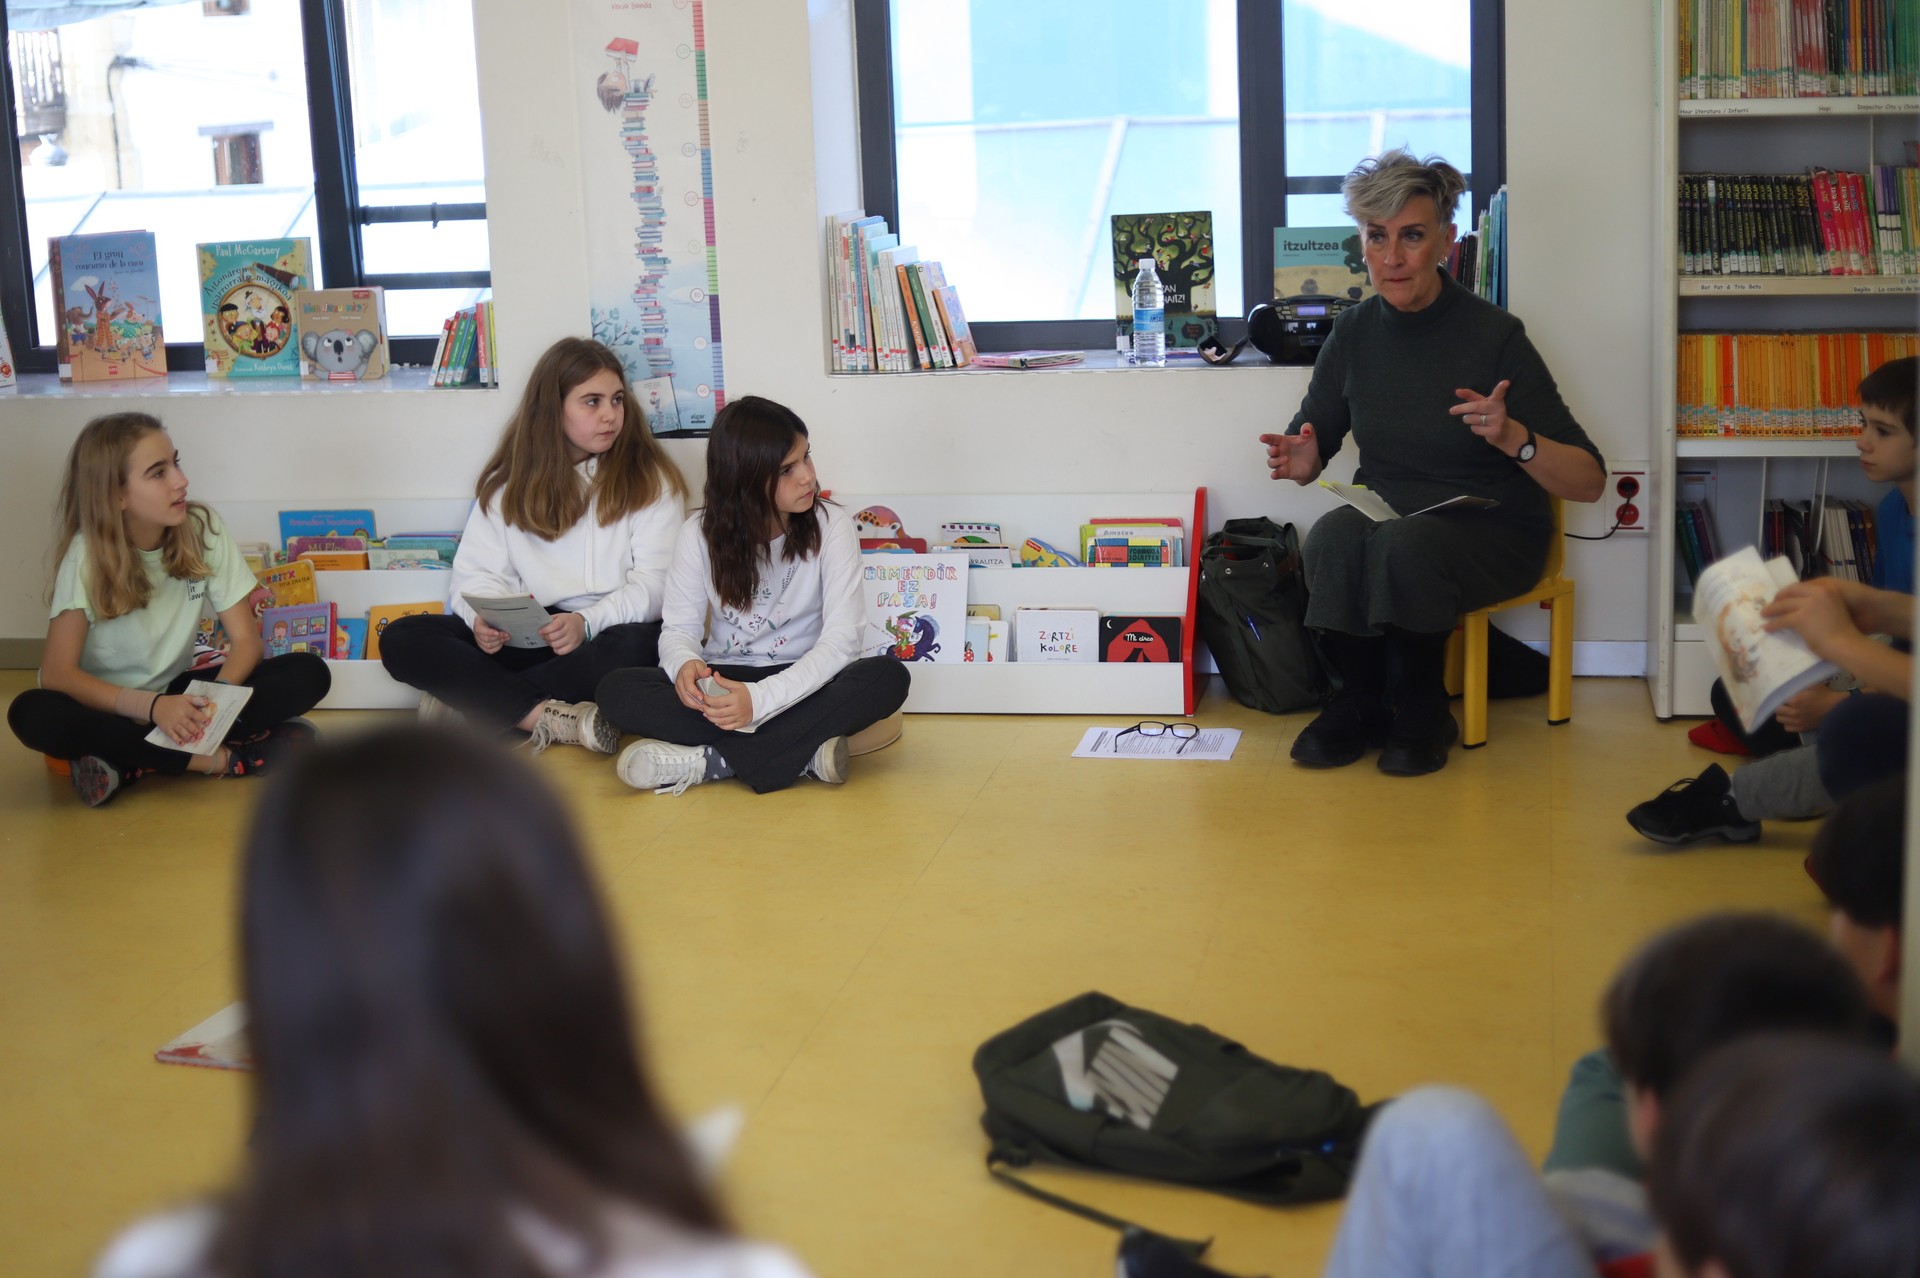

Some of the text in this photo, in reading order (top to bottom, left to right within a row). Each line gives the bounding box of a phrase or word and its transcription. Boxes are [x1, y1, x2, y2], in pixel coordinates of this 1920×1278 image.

[1283, 239, 1340, 251] itzultzea
[93, 251, 102, 261] El
[216, 244, 280, 259] Paul McCartney
[75, 261, 107, 271] concurso
[109, 260, 118, 269] de
[120, 259, 127, 268] la
[897, 580, 920, 593] EZ
[877, 592, 937, 609] PASA!
[1039, 628, 1075, 642] ZORTZI
[1125, 633, 1138, 642] Mi
[1040, 643, 1078, 654] KOLORE
